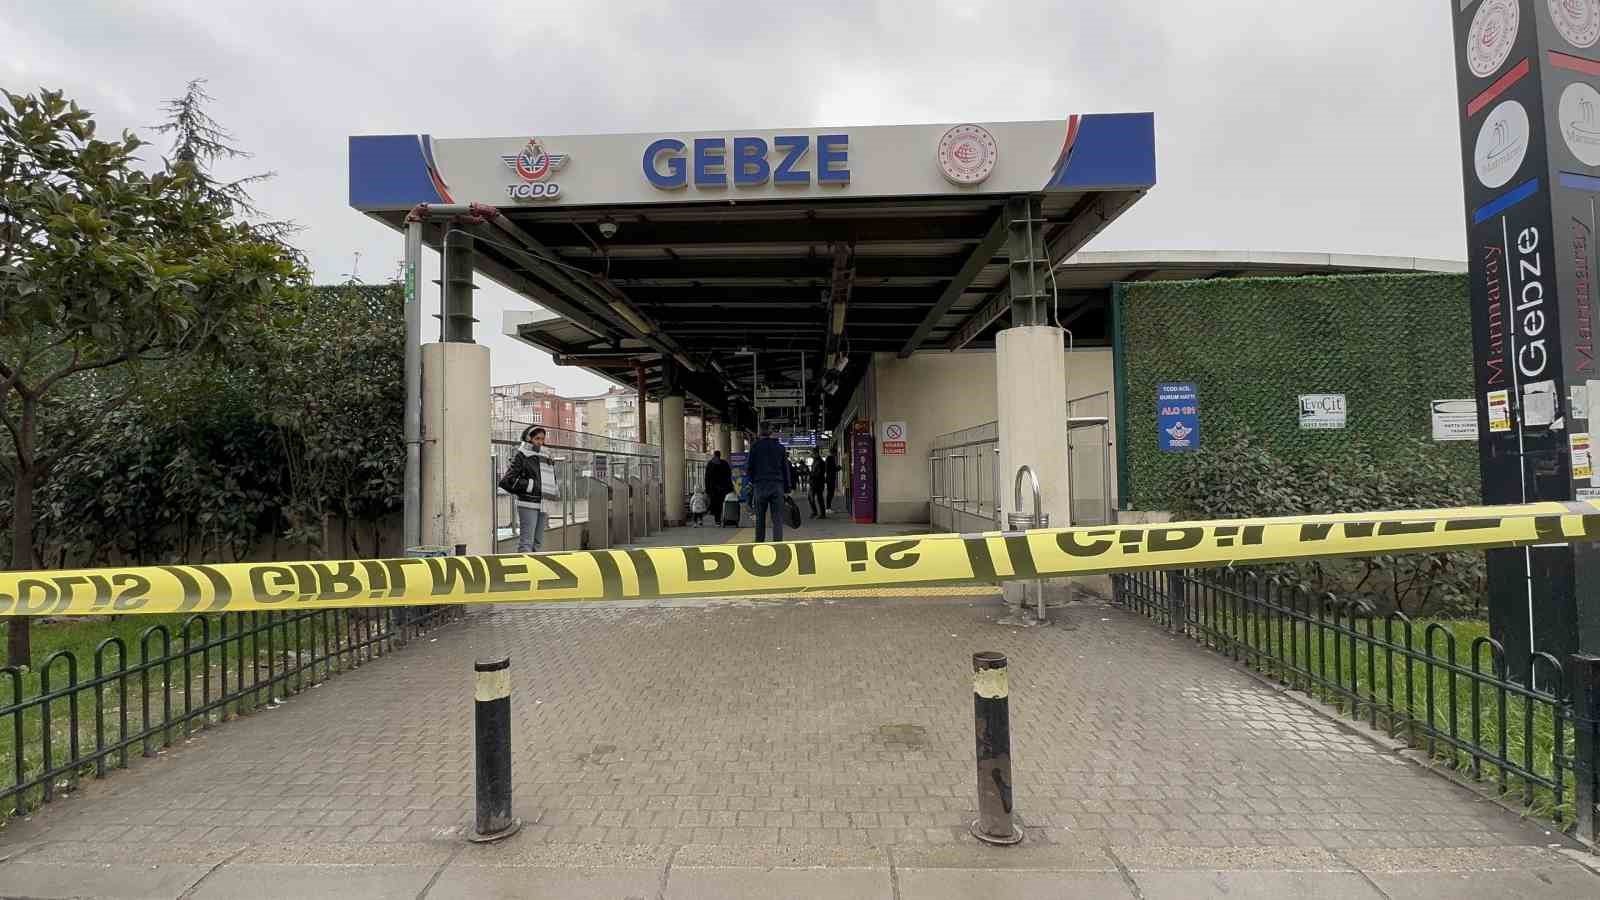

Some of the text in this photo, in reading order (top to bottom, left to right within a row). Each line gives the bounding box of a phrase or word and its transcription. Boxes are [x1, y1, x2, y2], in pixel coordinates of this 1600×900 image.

[642, 133, 850, 190] GEBZE
[508, 182, 561, 200] TCDD
[1483, 244, 1505, 385] Marmaray
[1516, 226, 1547, 377] Gebze
[1161, 406, 1180, 416] ALO
